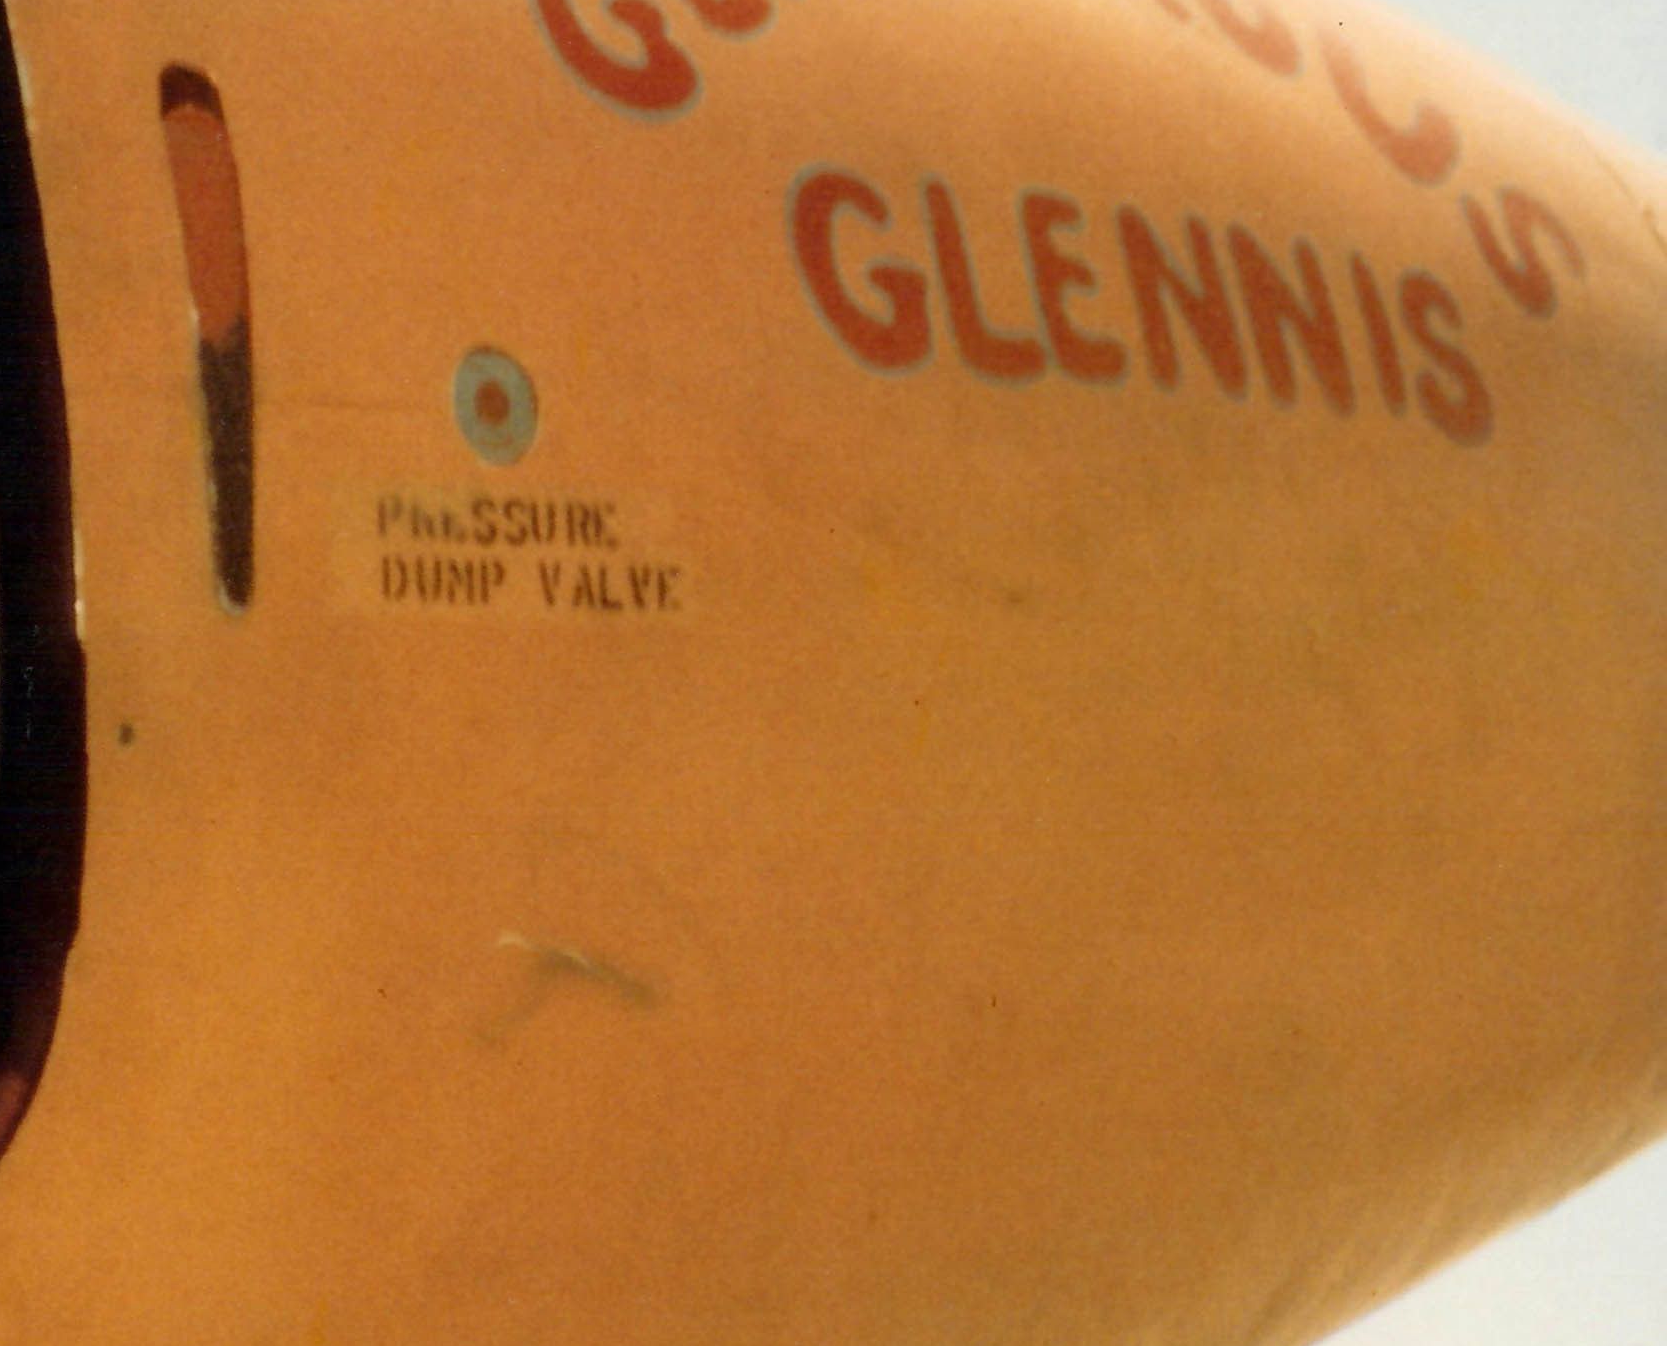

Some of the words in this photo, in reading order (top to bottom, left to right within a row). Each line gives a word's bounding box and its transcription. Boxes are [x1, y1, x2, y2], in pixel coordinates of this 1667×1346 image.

[790, 164, 1494, 448] GLENNIS
[376, 494, 621, 551] PRESSURE
[379, 555, 507, 606] DUMP
[539, 560, 685, 613] VALVE
